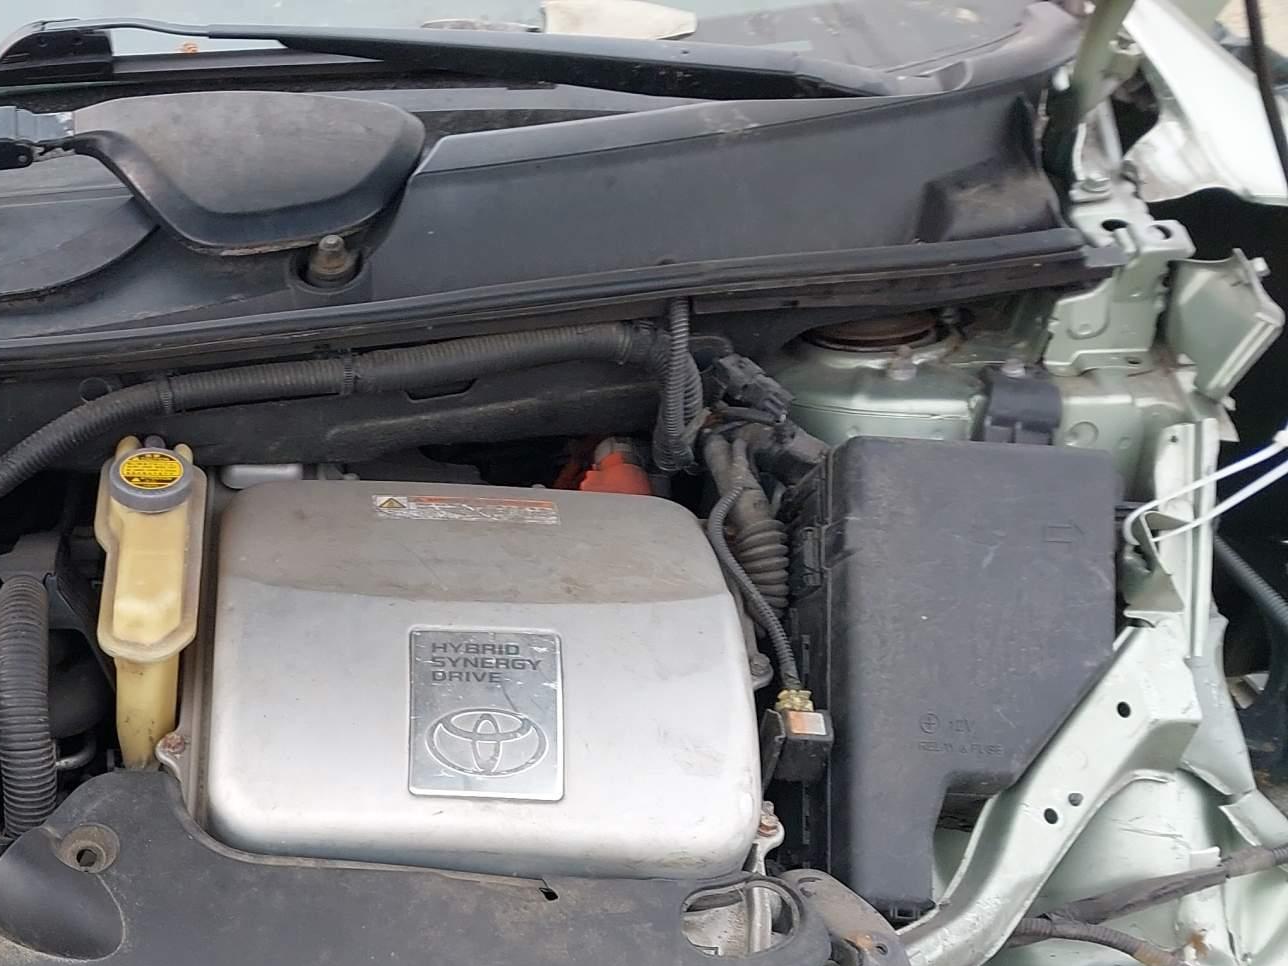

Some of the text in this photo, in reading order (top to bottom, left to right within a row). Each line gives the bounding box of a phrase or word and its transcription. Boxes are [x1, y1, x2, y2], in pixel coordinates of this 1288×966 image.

[432, 642, 520, 656] HYBRID
[431, 656, 542, 671] SYNERGY
[432, 670, 502, 683] DRIVE
